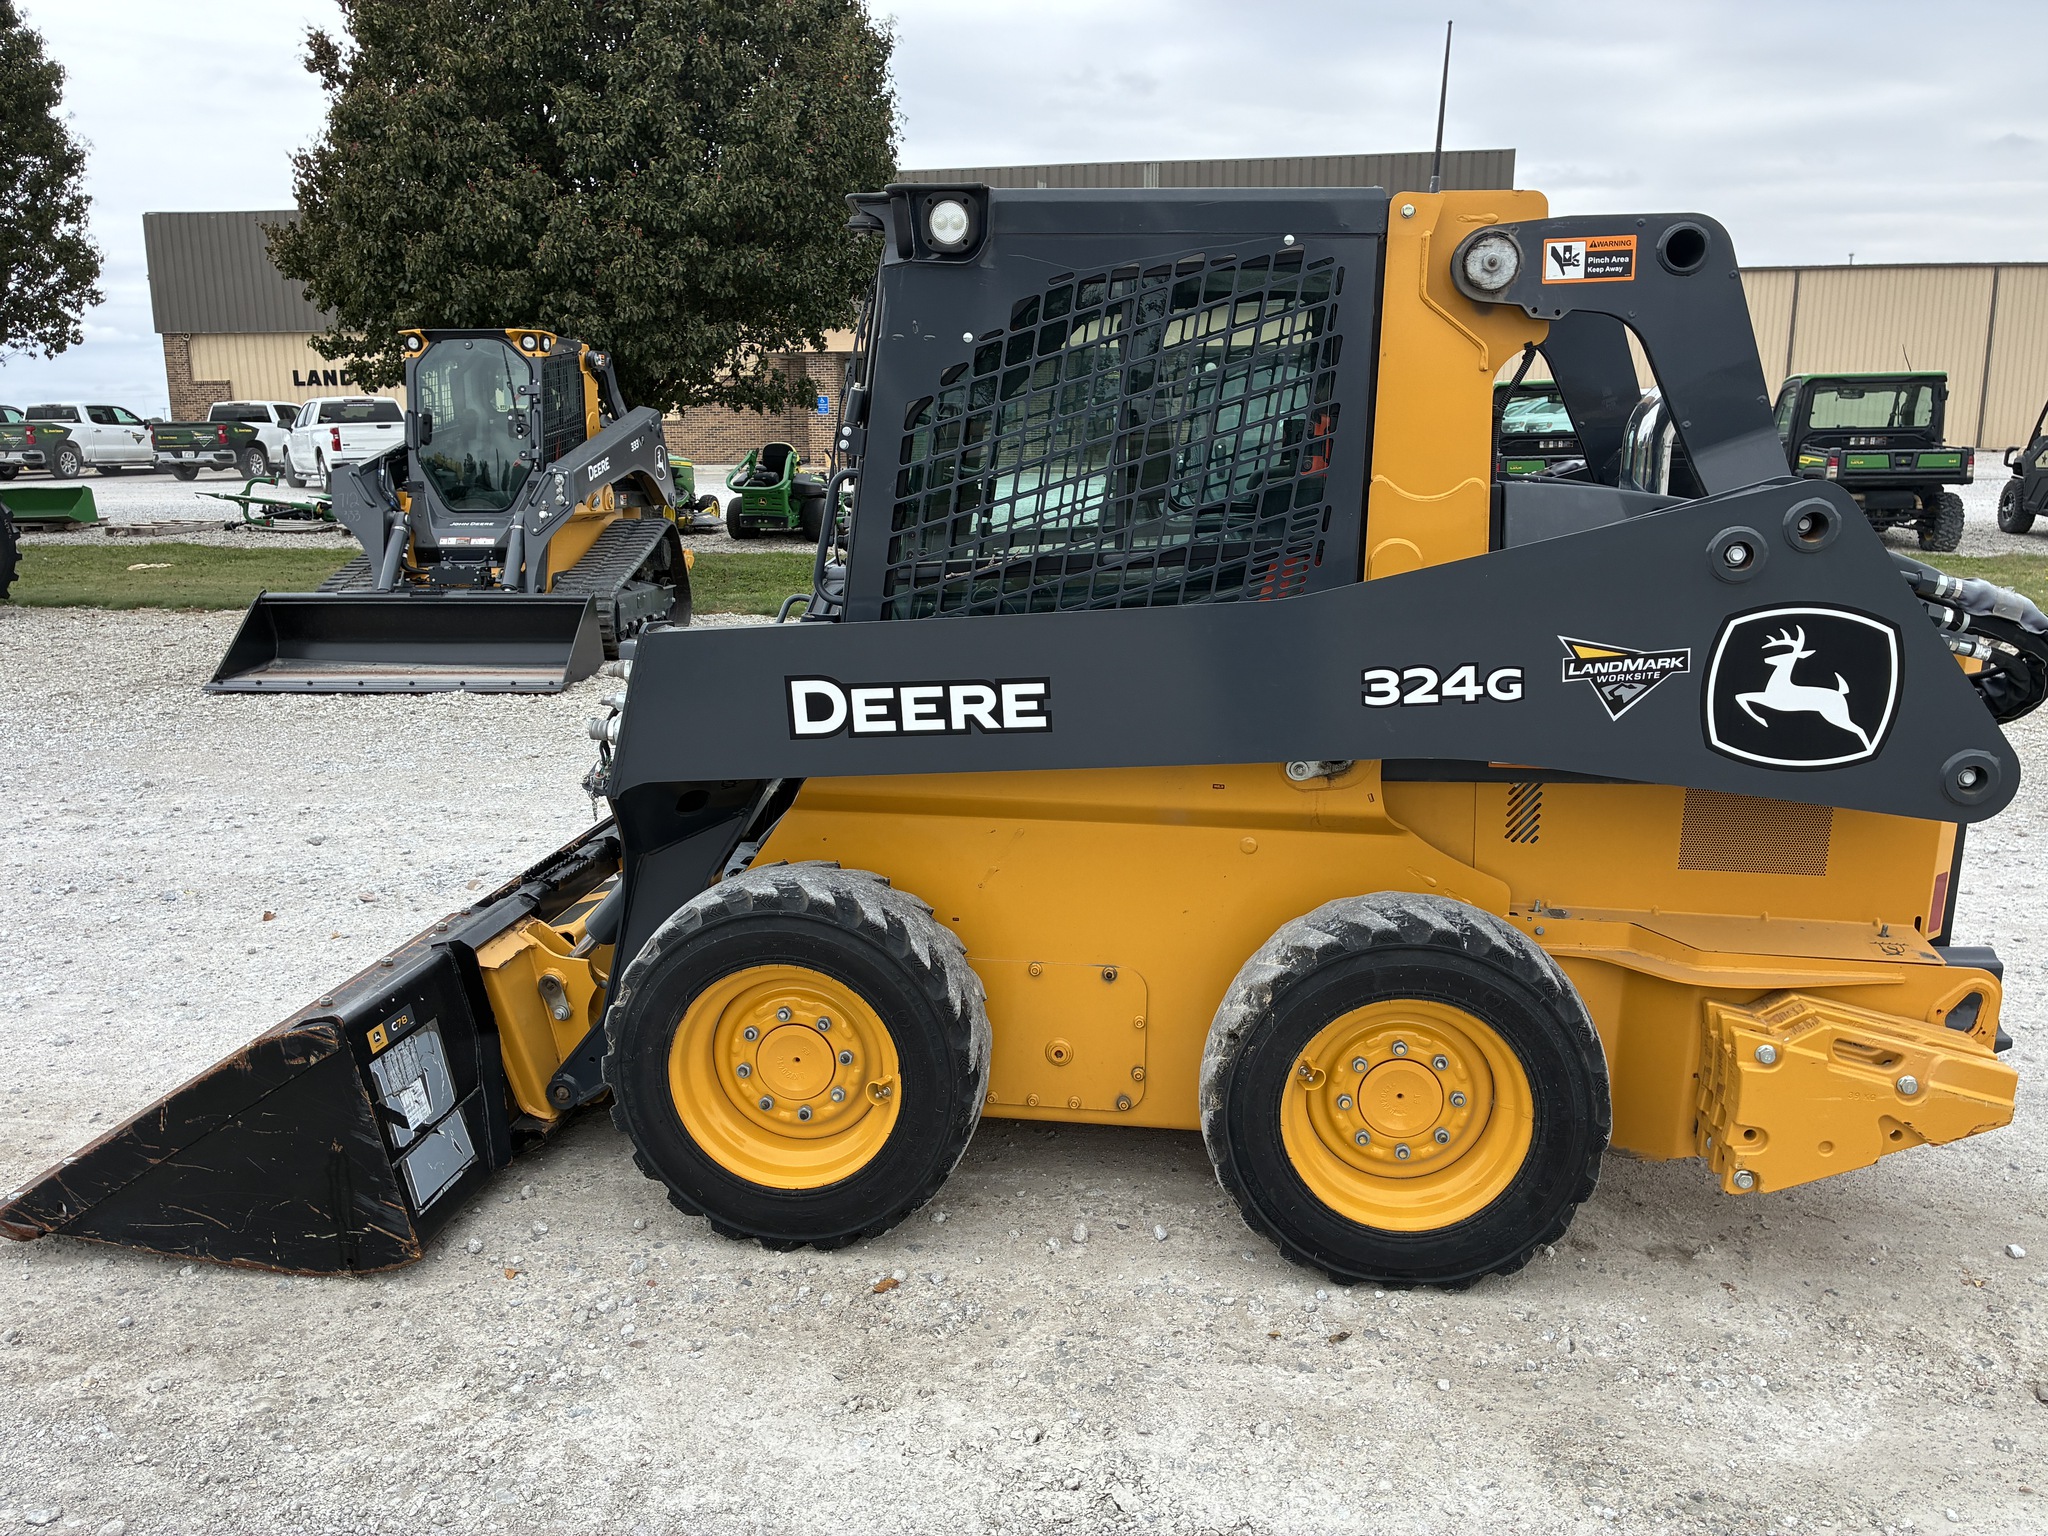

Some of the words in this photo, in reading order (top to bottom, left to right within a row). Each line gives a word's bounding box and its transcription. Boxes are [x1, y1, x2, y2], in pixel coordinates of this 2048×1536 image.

[1597, 240, 1632, 248] WARNING
[1587, 256, 1610, 264] Pinch
[1611, 255, 1629, 263] Area
[1587, 266, 1604, 274] Keep
[1605, 265, 1623, 273] Away
[292, 370, 356, 386] LAND
[587, 456, 611, 482] DEERE
[335, 492, 360, 508] 712
[1567, 656, 1685, 676] LANDMARK
[1596, 671, 1661, 683] WORKSITE
[1363, 664, 1524, 707] 324G
[788, 677, 1050, 737] DEERE
[391, 1014, 408, 1031] C78
